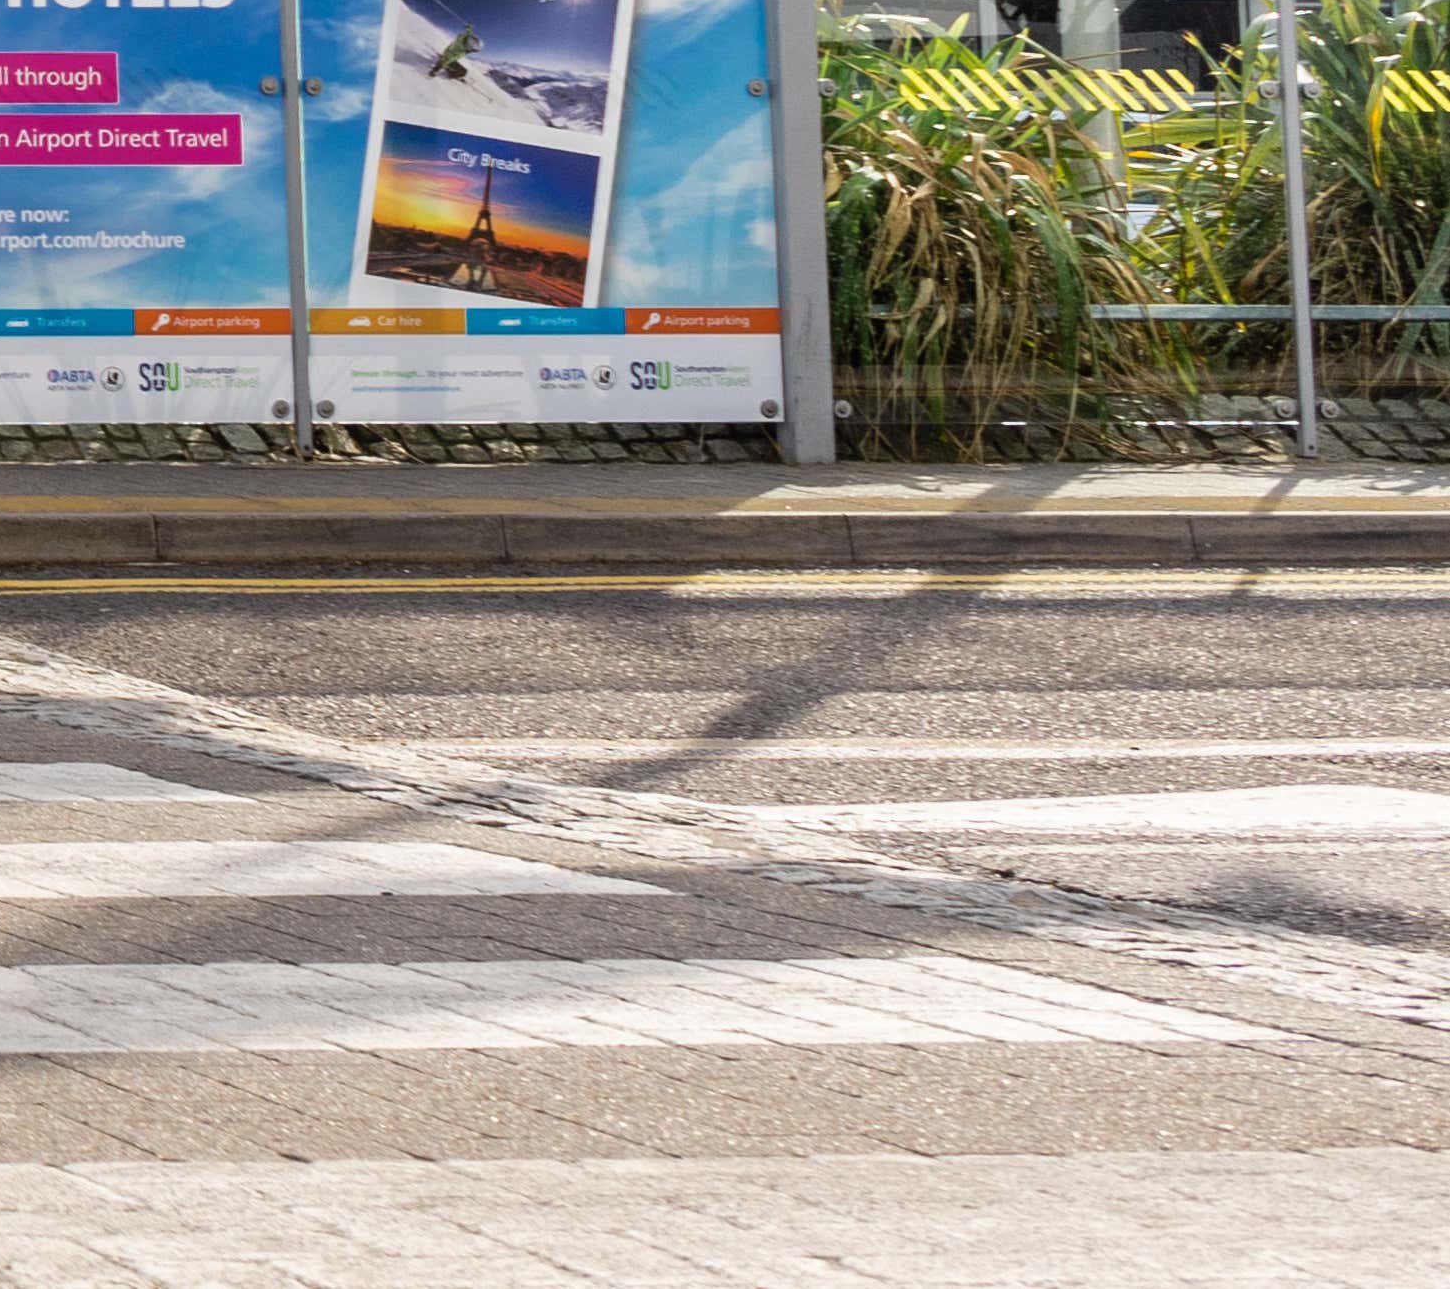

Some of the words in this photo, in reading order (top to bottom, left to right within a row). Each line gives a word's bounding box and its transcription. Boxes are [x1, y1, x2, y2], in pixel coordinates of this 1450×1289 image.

[14, 67, 102, 91] through
[15, 128, 92, 152] Airport
[98, 128, 160, 148] Direct
[165, 128, 228, 148] Travel
[447, 148, 478, 168] City
[481, 155, 531, 174] Breaks
[20, 208, 69, 224] now:
[37, 316, 87, 328] Transfers
[173, 316, 214, 330] Airport
[216, 315, 261, 330] parking
[377, 314, 397, 327] Car
[399, 314, 422, 327] hire
[529, 314, 578, 326] Transfers
[664, 314, 704, 328] Airport
[706, 314, 751, 328] parking
[62, 370, 96, 383] ABTA
[139, 362, 180, 392] SOU
[550, 368, 587, 381] ABTA
[630, 361, 671, 390] SOU
